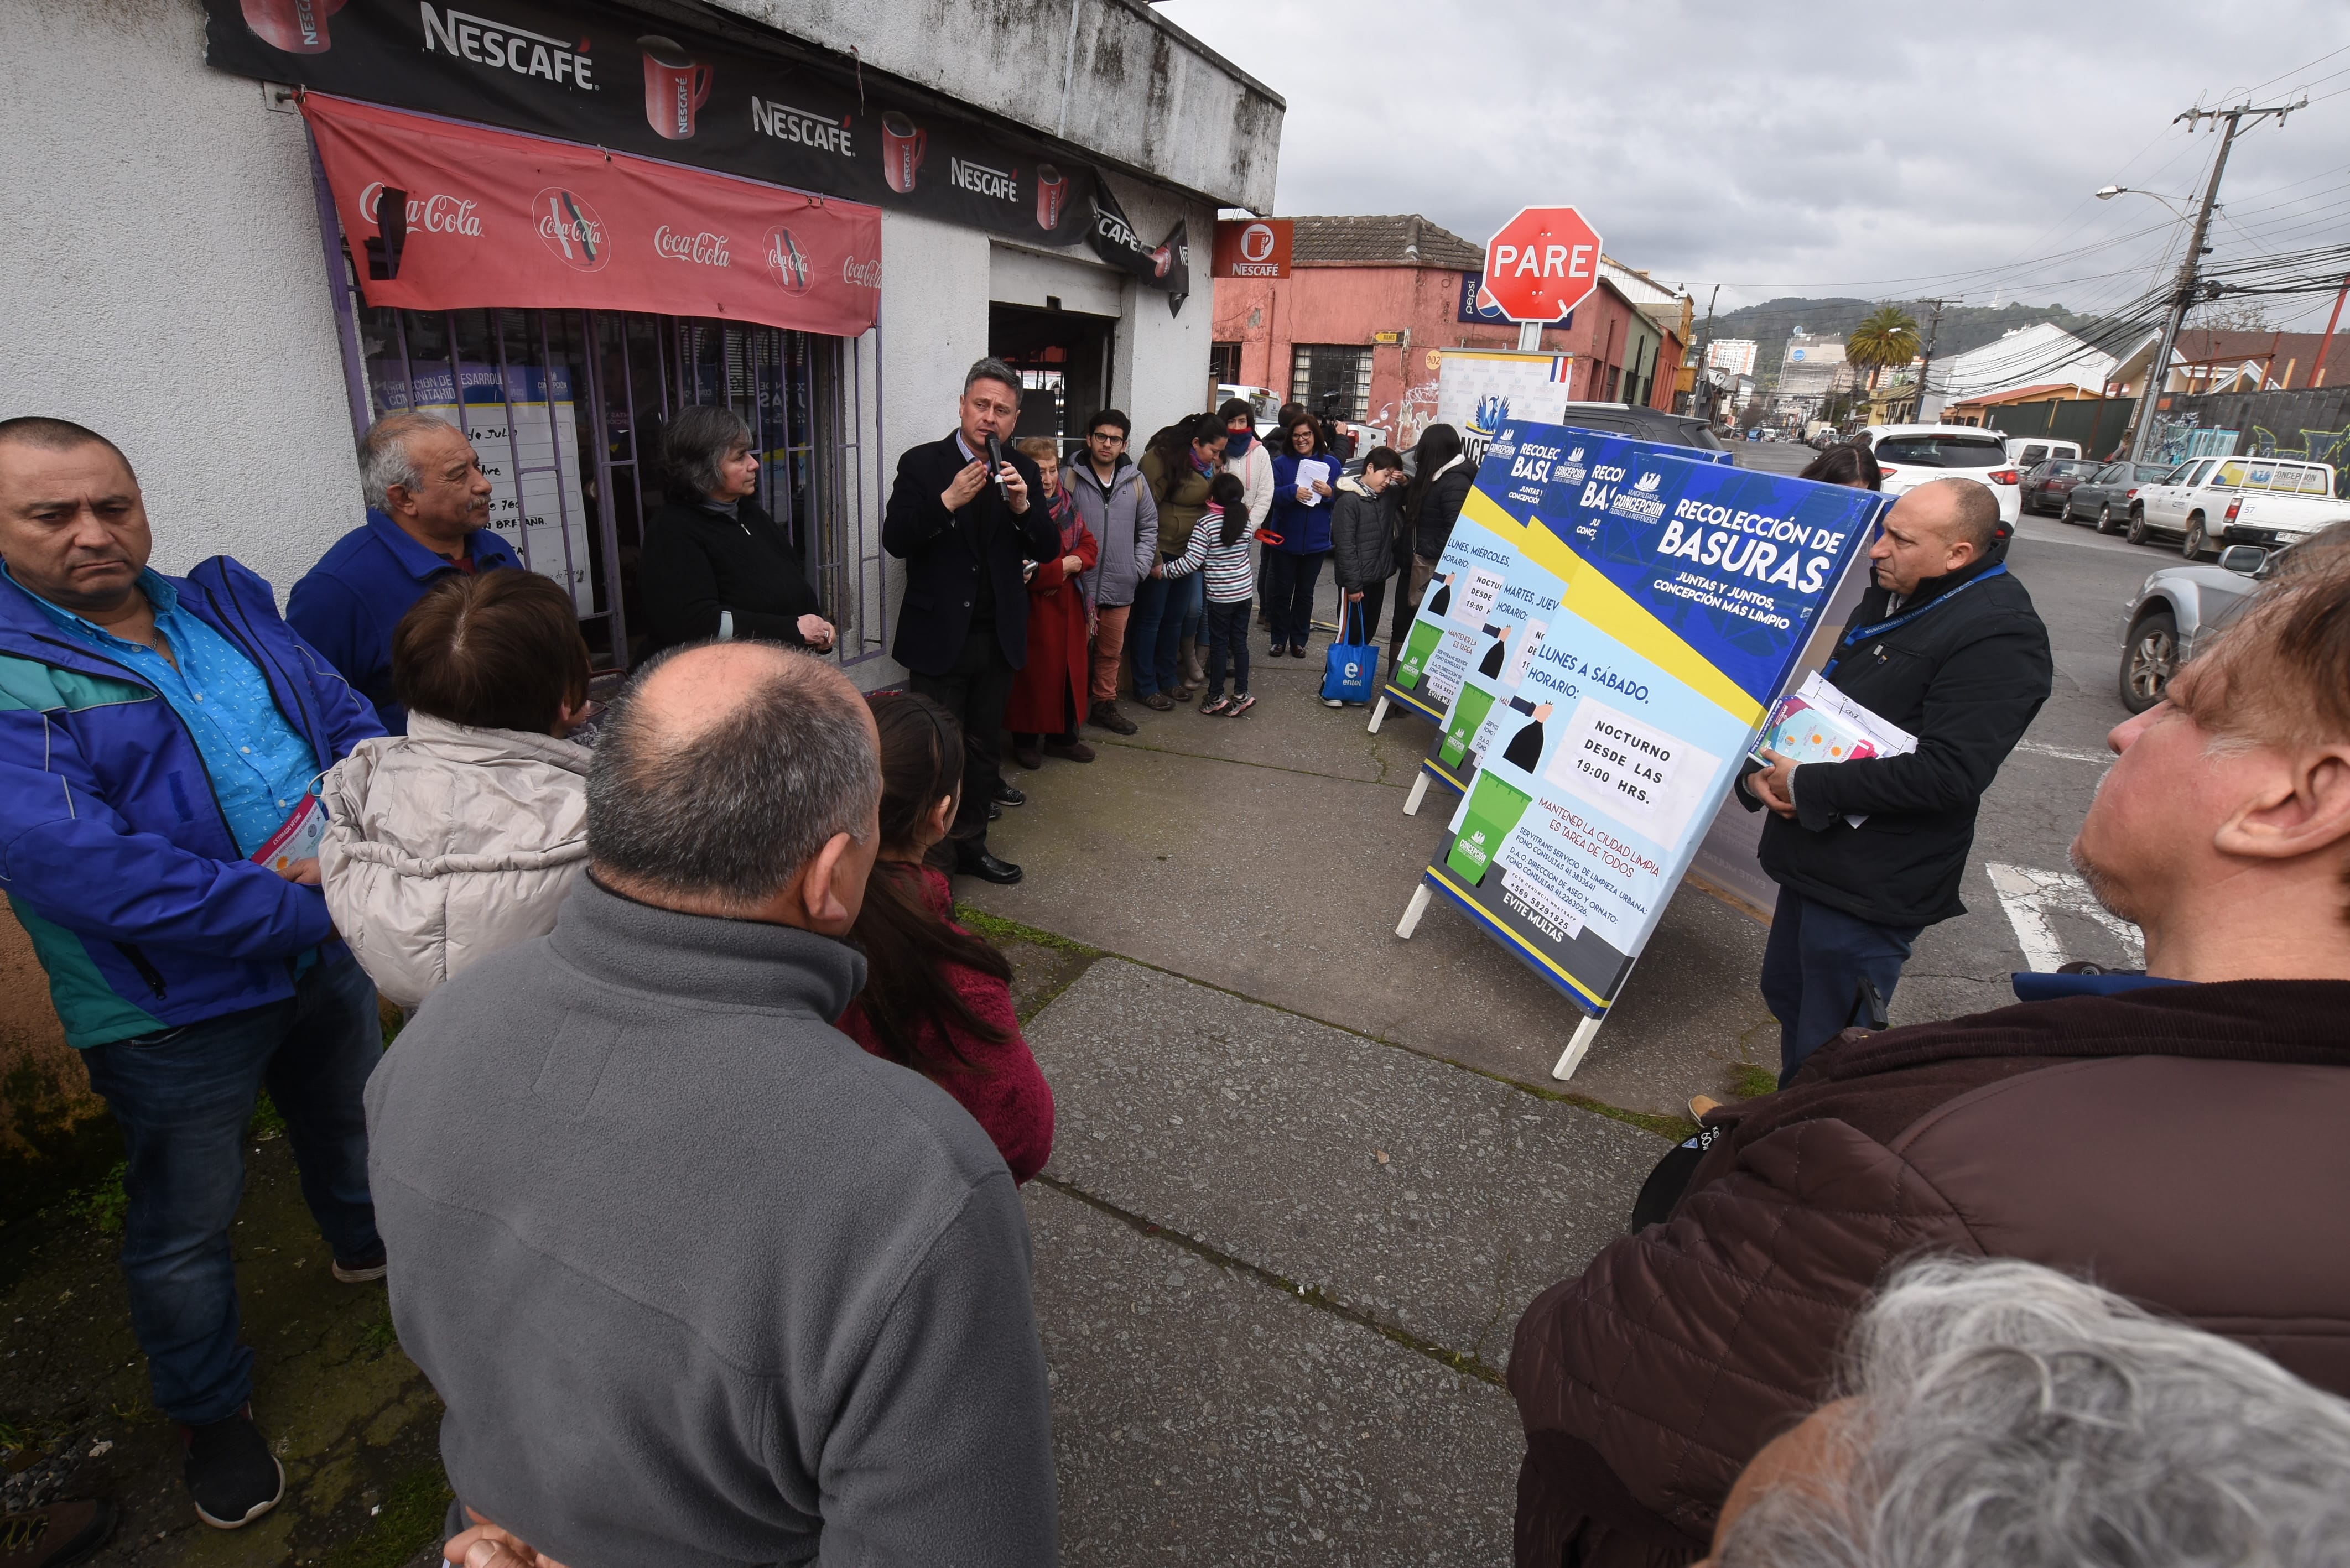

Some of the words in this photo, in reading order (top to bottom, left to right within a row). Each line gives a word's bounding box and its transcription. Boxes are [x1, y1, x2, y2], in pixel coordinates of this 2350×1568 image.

[420, 2, 594, 90] NESCAFÉ
[678, 78, 688, 133] NESCAFÉ
[752, 96, 852, 157] NESCAFÉ
[951, 157, 1017, 202] NESCAFÉ
[654, 225, 729, 268] Coca-Cola
[1494, 245, 1593, 278] PARE
[1233, 263, 1278, 276] NESCAFÉ
[1465, 280, 1475, 314] pepsi
[1427, 356, 1441, 365] 902
[438, 374, 453, 386] DE
[1489, 443, 1516, 455] CONCEPCIÓN
[1554, 465, 1587, 480] CONCEPCIÓN
[1520, 486, 1539, 496] JUNTAS
[1614, 494, 1666, 517] CONCEPCIÓN
[1675, 498, 1811, 548] RECOLECCIÓN
[1811, 529, 1845, 554] DE
[1442, 554, 1470, 569] HORARIO:
[1447, 539, 1469, 553] LUNES,
[1470, 546, 1510, 567] MIÉRCOLES,
[1657, 520, 1830, 594] BASURAS
[1466, 600, 1483, 612] 19:00
[1470, 588, 1492, 601] DESDE
[1504, 584, 1535, 606] MARTES,
[1654, 579, 1722, 607] CONCEPCIÓN
[1722, 598, 1748, 617] MÁS
[1748, 608, 1790, 630] LIMPIO
[1676, 571, 1717, 591] JUNTAS
[1717, 583, 1727, 595] Y
[1727, 587, 1775, 611] JUNTOS,
[1496, 601, 1528, 621] HORARIO:
[1864, 617, 1904, 635] MUNICIPALIDAD
[1447, 629, 1471, 644] MANTENER
[1459, 643, 1473, 655] TAREA
[1528, 666, 1580, 699] HORARIO:
[1538, 644, 1578, 671] LUNES
[1577, 662, 1589, 677] A
[1591, 666, 1650, 705] SÁBADO.
[1477, 742, 1487, 752] FONO
[1484, 726, 1494, 736] FONO
[1594, 720, 1671, 762] NOCTURNO
[1584, 739, 1628, 767] DESDE
[1634, 763, 1663, 784] LAS
[1576, 758, 1610, 783] 19:00
[1617, 779, 1651, 805] HRS.
[272, 825, 292, 846] ESTIMADO
[1459, 838, 1487, 863] CONCEPCIÓN
[1538, 796, 1583, 829] MANTENER
[1582, 822, 1595, 837] LA
[1597, 831, 1631, 857] CIUDAD
[1630, 851, 1660, 878] LIMPIA
[1548, 819, 1561, 832] ES
[1561, 825, 1586, 850] TAREA
[1587, 842, 1602, 857] DE
[1601, 850, 1635, 878] TODOS
[1516, 835, 1533, 849] FONO
[1533, 846, 1565, 871] CONSULTAS
[1564, 867, 1597, 892] 41.3833641
[1520, 827, 1553, 852] SERVITRANS
[1553, 848, 1580, 869] SERVICIO
[1582, 867, 1592, 877] DE
[1590, 872, 1618, 895] LIMPIEZA
[1619, 891, 1648, 915] URBANA:
[1506, 855, 1522, 869] FONO
[1522, 866, 1554, 892] CONSULTAS
[1554, 888, 1588, 917] 41.2263026.
[1510, 846, 1527, 863] D.A.O.
[1527, 858, 1559, 883] DIRECCIÓN
[1558, 879, 1568, 889] DE
[1566, 885, 1583, 900] ASEO
[1584, 896, 1591, 904] Y
[1589, 901, 1619, 925] ORNATO:
[1512, 872, 1524, 883] FOTO
[1525, 882, 1550, 902] DENUNCIA
[1550, 901, 1577, 922] WHATSAPP
[1502, 892, 1530, 918] EVITE
[1527, 910, 1565, 943] MULTAS
[1511, 883, 1528, 899] +569
[1530, 897, 1569, 929] 58291825
